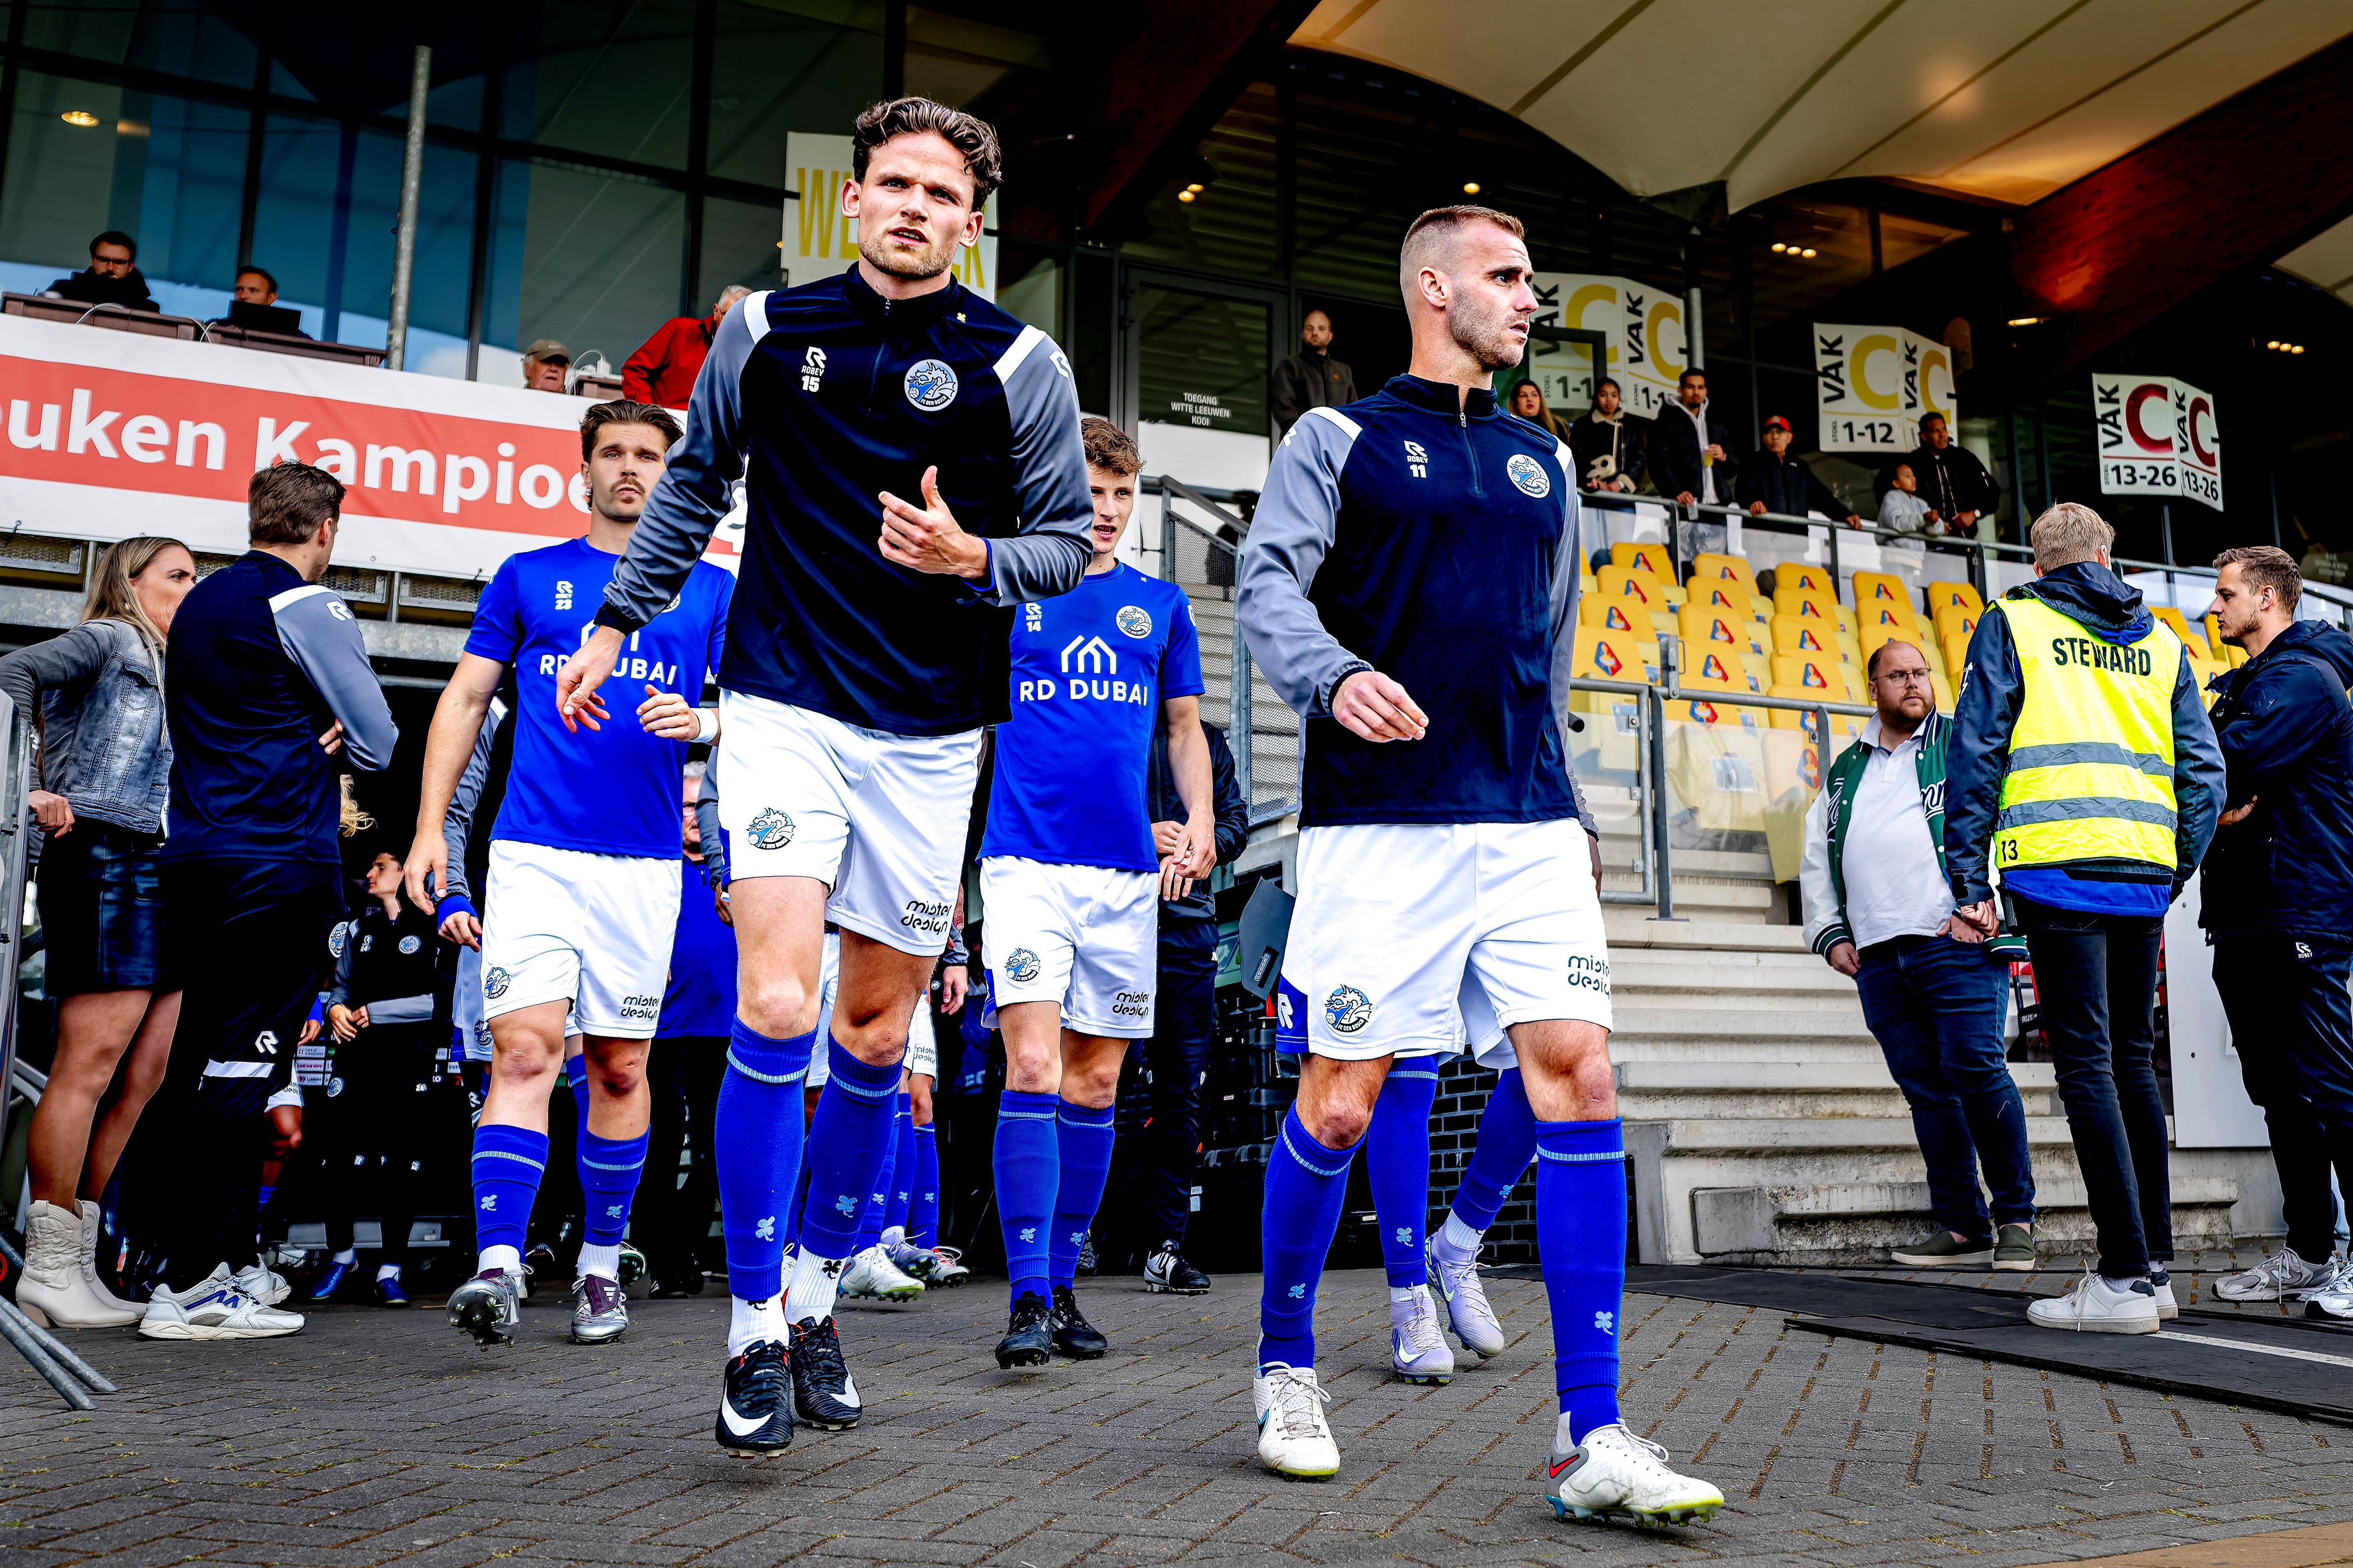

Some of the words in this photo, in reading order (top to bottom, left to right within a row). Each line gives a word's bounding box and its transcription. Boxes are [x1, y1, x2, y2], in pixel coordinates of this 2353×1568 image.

[1626, 290, 1643, 364] VAK
[1646, 301, 1683, 381] C
[802, 365, 824, 377] ROBEY
[1819, 334, 1845, 404] VAK
[1850, 334, 1899, 409] C
[1904, 339, 1917, 409] VAK
[802, 376, 820, 392] 15
[1556, 376, 1591, 399] 1-1
[1919, 349, 1951, 424] C
[935, 395, 947, 405] BOSCH
[1171, 401, 1194, 413] WITTE
[1195, 405, 1230, 418] LEEUWEN
[1183, 392, 1218, 406] TOEGANG
[1192, 415, 1210, 426] KOOI
[2097, 383, 2122, 450] VAK
[2125, 382, 2173, 453] C
[2175, 388, 2189, 453] VAK
[1842, 420, 1894, 444] 1-12
[2189, 396, 2216, 468] C
[0, 388, 227, 471] uken
[254, 417, 592, 514] Kampioe
[1407, 455, 1428, 463] ROBEY
[1410, 464, 1427, 478] 11
[2111, 464, 2176, 487] 13-26
[2184, 470, 2218, 501] 13-26
[555, 599, 572, 610] 23
[1026, 621, 1042, 632] 14
[2053, 638, 2151, 676] STEWARD
[611, 657, 677, 685] UBAI
[1020, 679, 1056, 702] RD
[1070, 679, 1147, 706] DUBAI
[2001, 839, 2018, 862] 13
[900, 913, 948, 935] design
[1568, 955, 1609, 977] miste
[1568, 971, 1610, 1000] desig
[620, 1007, 657, 1021] design
[1112, 1003, 1149, 1018] design
[914, 1046, 936, 1055] miste
